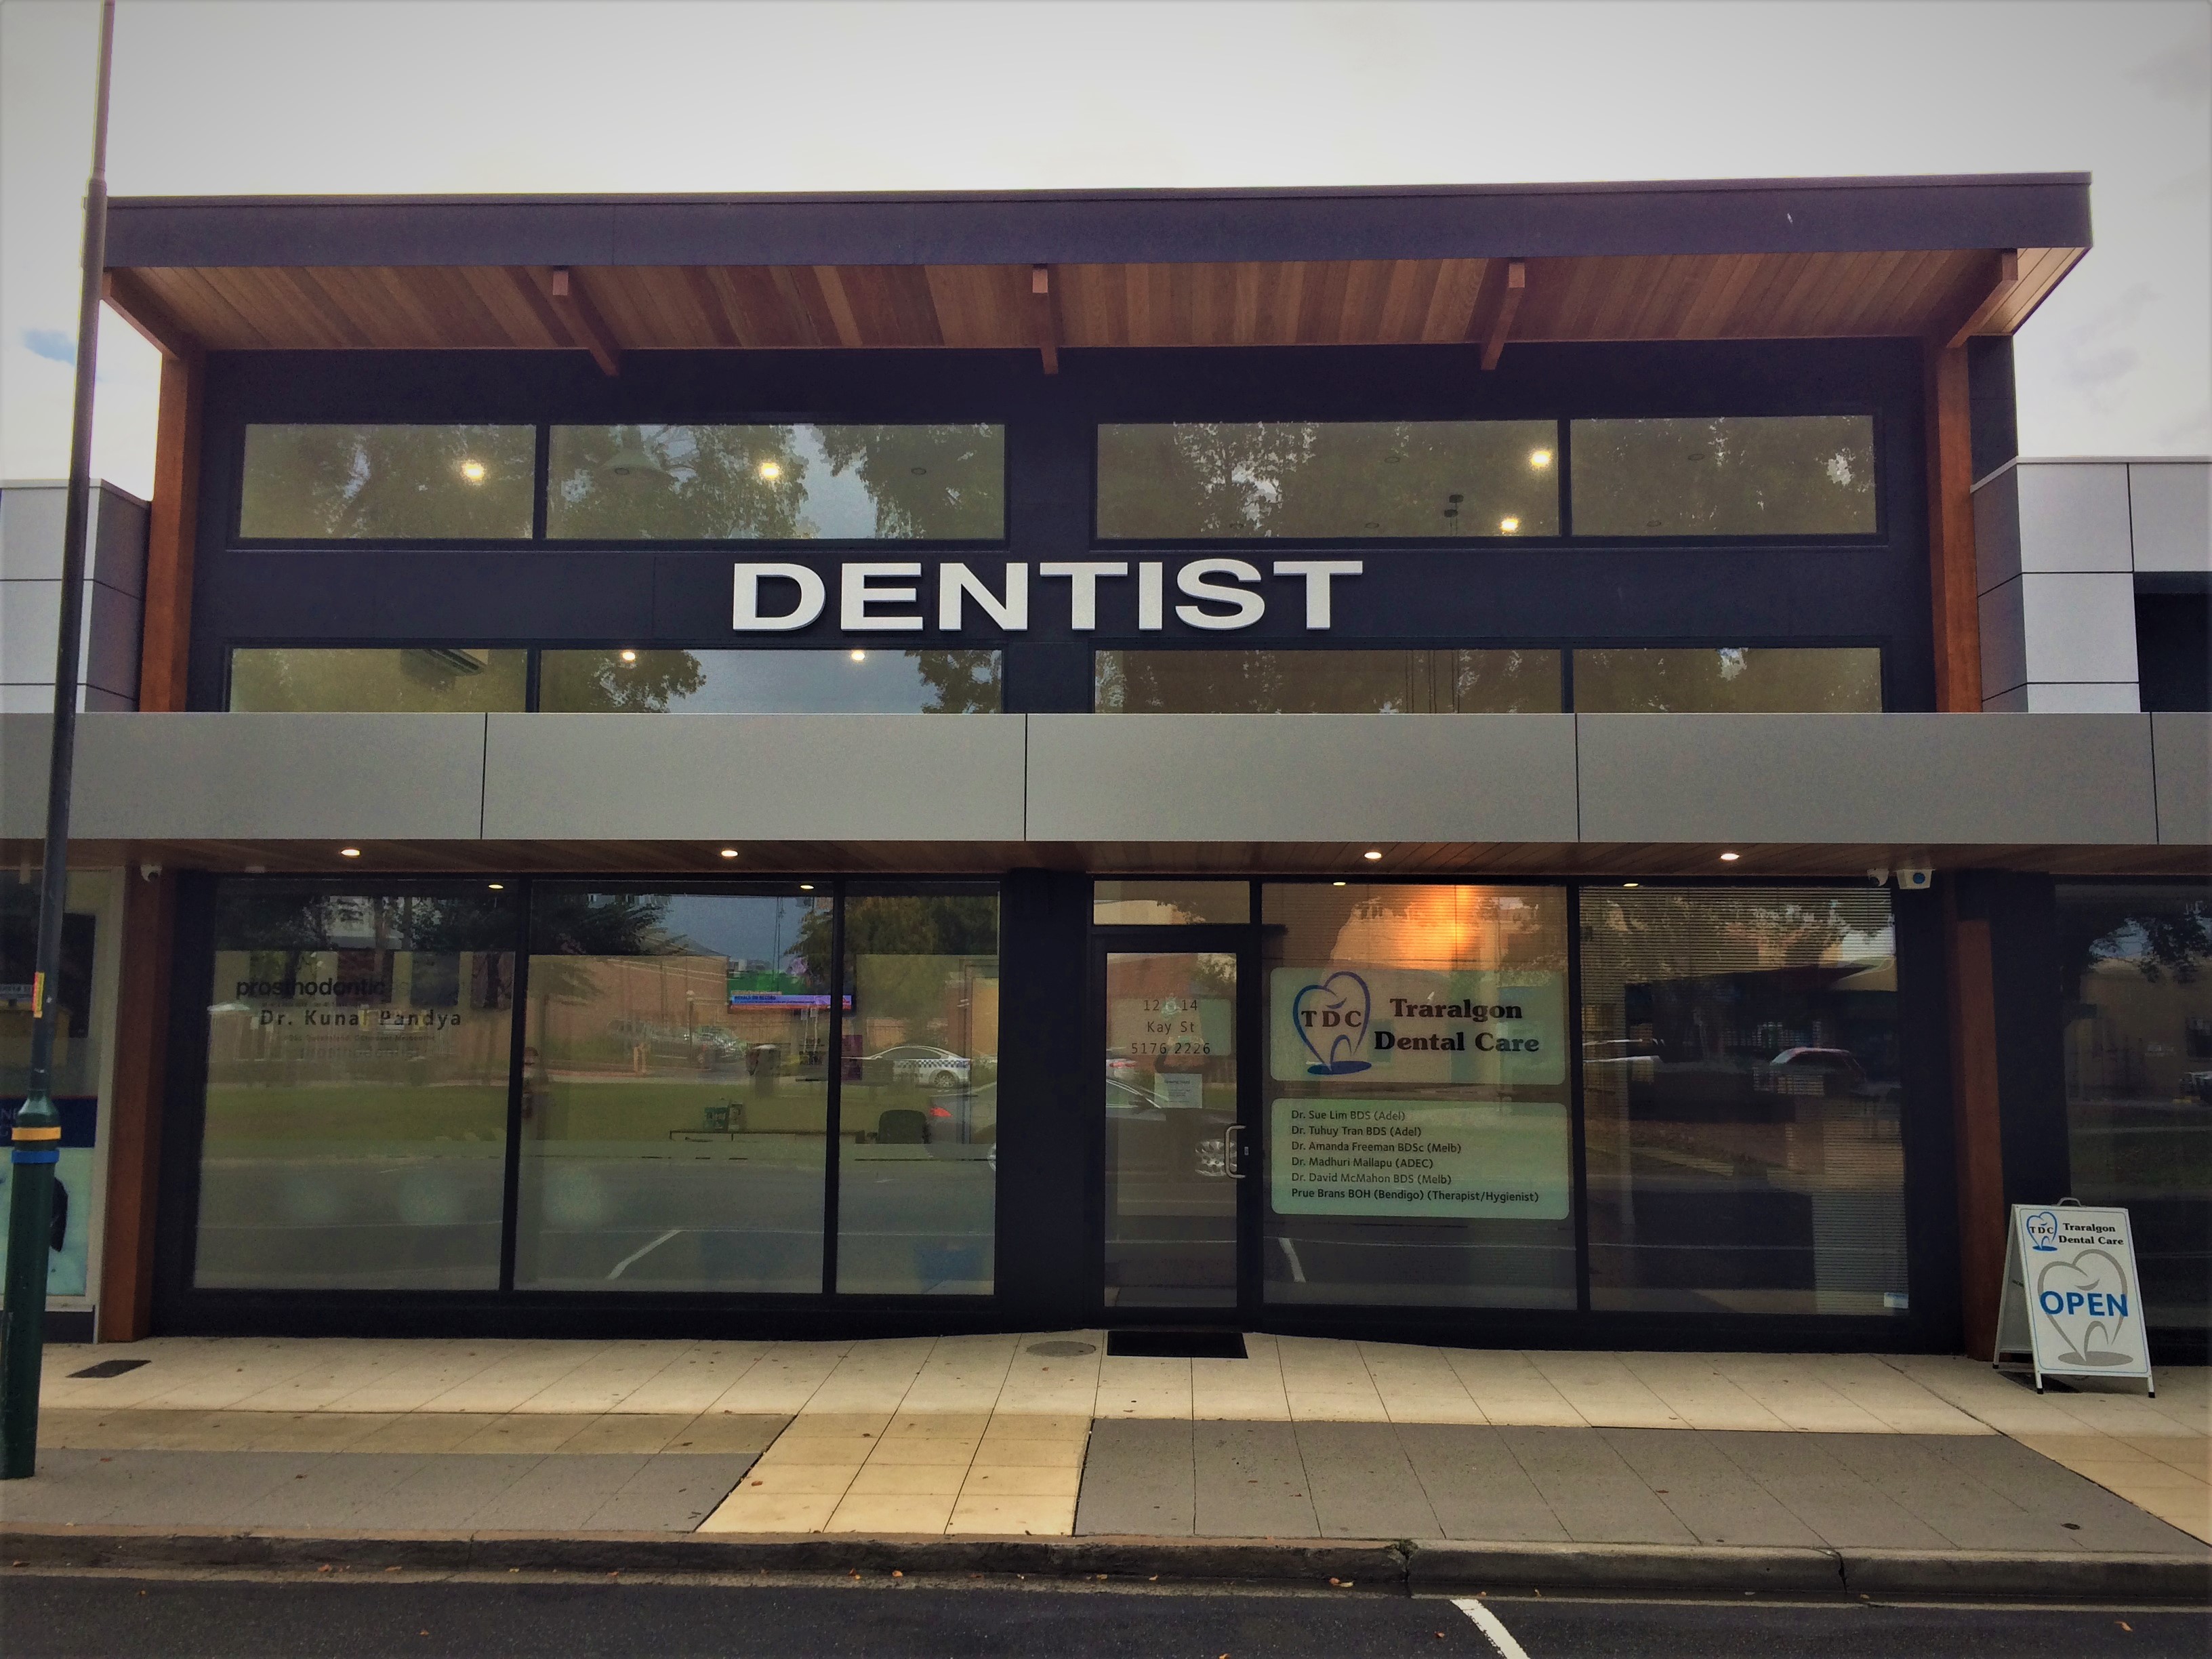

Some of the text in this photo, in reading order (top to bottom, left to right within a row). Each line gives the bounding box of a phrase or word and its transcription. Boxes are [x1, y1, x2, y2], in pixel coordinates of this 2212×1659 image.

[732, 558, 1363, 631] DENTIST
[236, 977, 385, 1000] proshodontic
[1390, 998, 1523, 1023] Traralgon
[260, 1009, 462, 1031] Dr. Kunal Pandya
[1301, 1010, 1362, 1027] TDC
[1147, 1021, 1195, 1035] Kay St
[1131, 1042, 1210, 1054] 5176 2226
[1374, 1031, 1540, 1052] Dental Care
[1292, 1110, 1406, 1121] Dr. Sue Lim BDS (Adel)
[1292, 1126, 1421, 1137] Dr. Tuhuy Tran BDS (Adel)
[1292, 1141, 1461, 1153] Dr. Amanda Freeman BDSc (Melb)
[1292, 1157, 1433, 1169] Dr. Madhuri Mallapu (ADEC)
[1292, 1172, 1452, 1185] Dr. David McMahon BDS (Melb)
[1292, 1188, 1539, 1203] Prue Brans BOH (Bendigo) (Therapist/Hygienist)
[2029, 1226, 2054, 1234] TDC
[2062, 1223, 2116, 1233] Traralgon
[2059, 1235, 2125, 1245] Dental Care
[2040, 1290, 2129, 1317] OPEN
